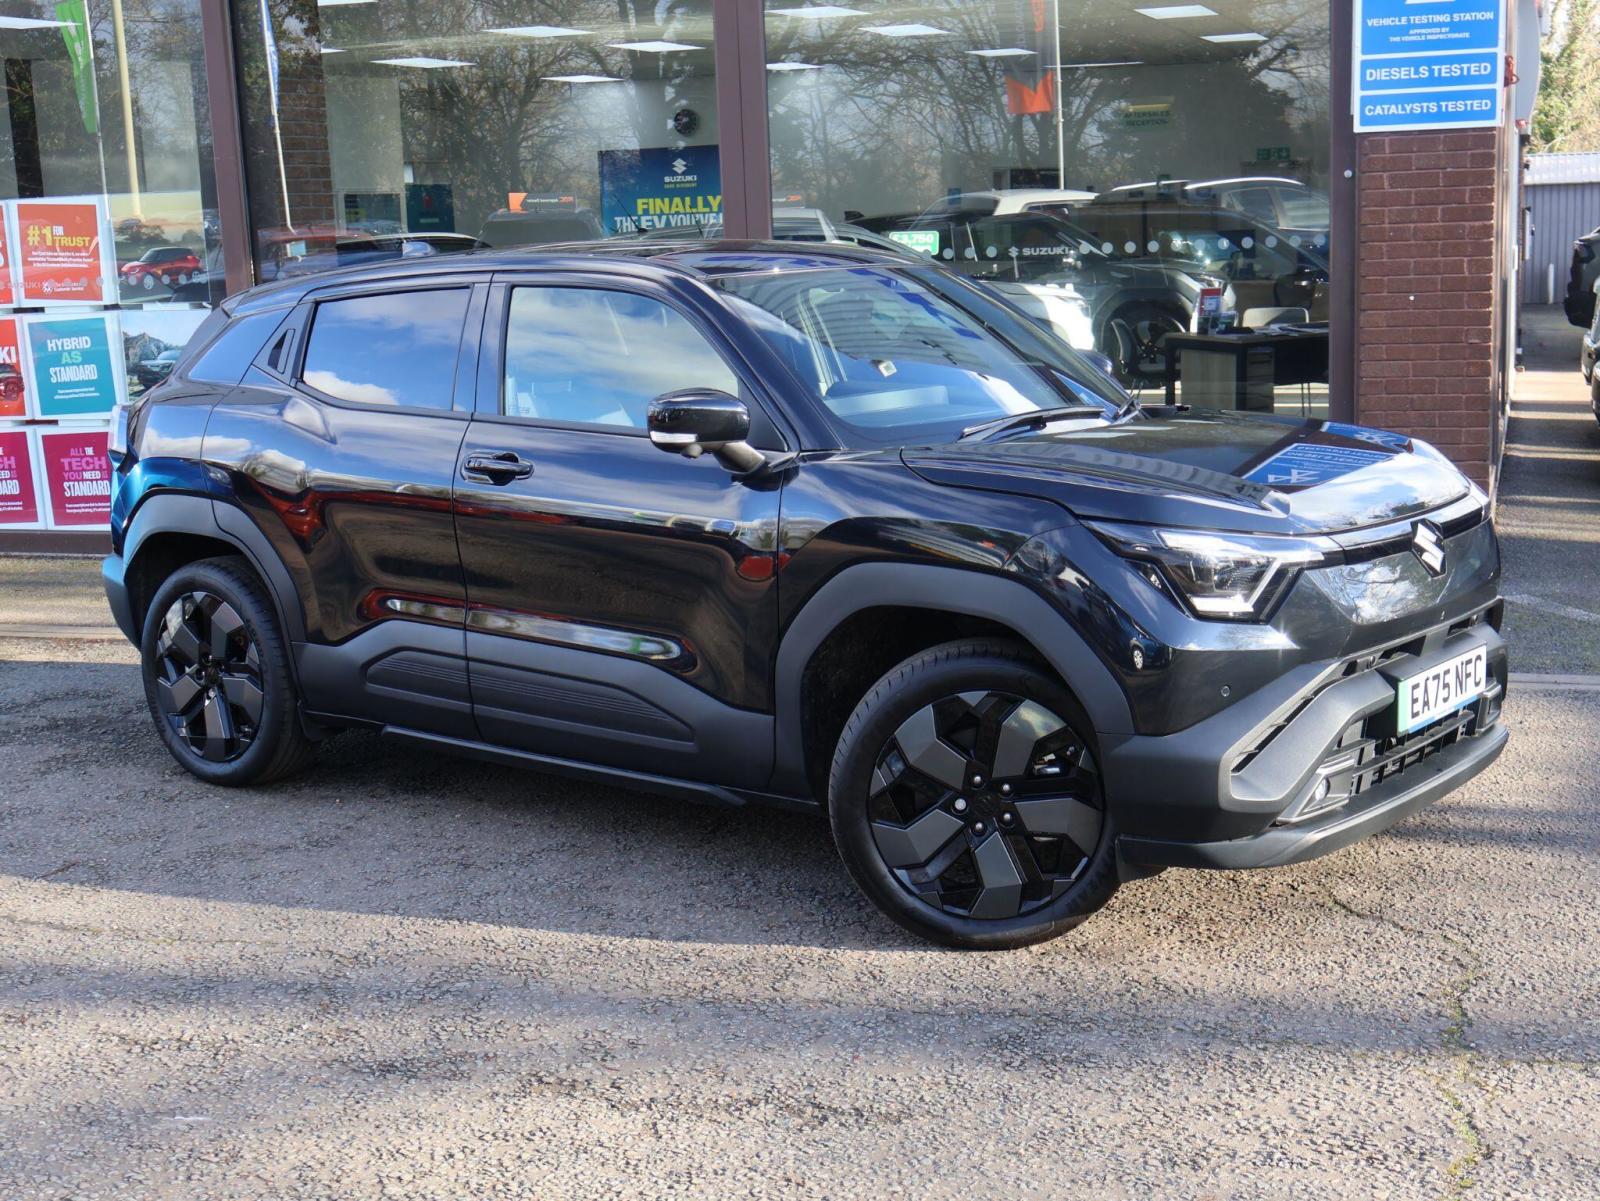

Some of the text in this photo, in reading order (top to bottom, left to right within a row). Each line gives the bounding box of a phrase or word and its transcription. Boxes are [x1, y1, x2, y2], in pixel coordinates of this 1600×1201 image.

[1366, 11, 1494, 27] VEHICLE TESTING STATION
[1365, 63, 1491, 81] DIESELS TESTED
[1365, 100, 1491, 116] CATALYSTS TESTED
[664, 175, 697, 183] SUZUKI
[637, 195, 722, 214] FINALLY
[641, 213, 668, 230] EV
[27, 225, 53, 247] #1
[53, 236, 91, 247] TRUST
[1022, 246, 1070, 256] SUZUKI
[47, 336, 91, 351] HYBRID
[61, 350, 82, 364] AS
[49, 364, 98, 383] STANDARD
[62, 456, 107, 471] TECH
[63, 471, 82, 480] YOU
[83, 470, 101, 479] NEED
[63, 480, 110, 497] STANDARD
[1410, 654, 1483, 719] EA75 NFC
